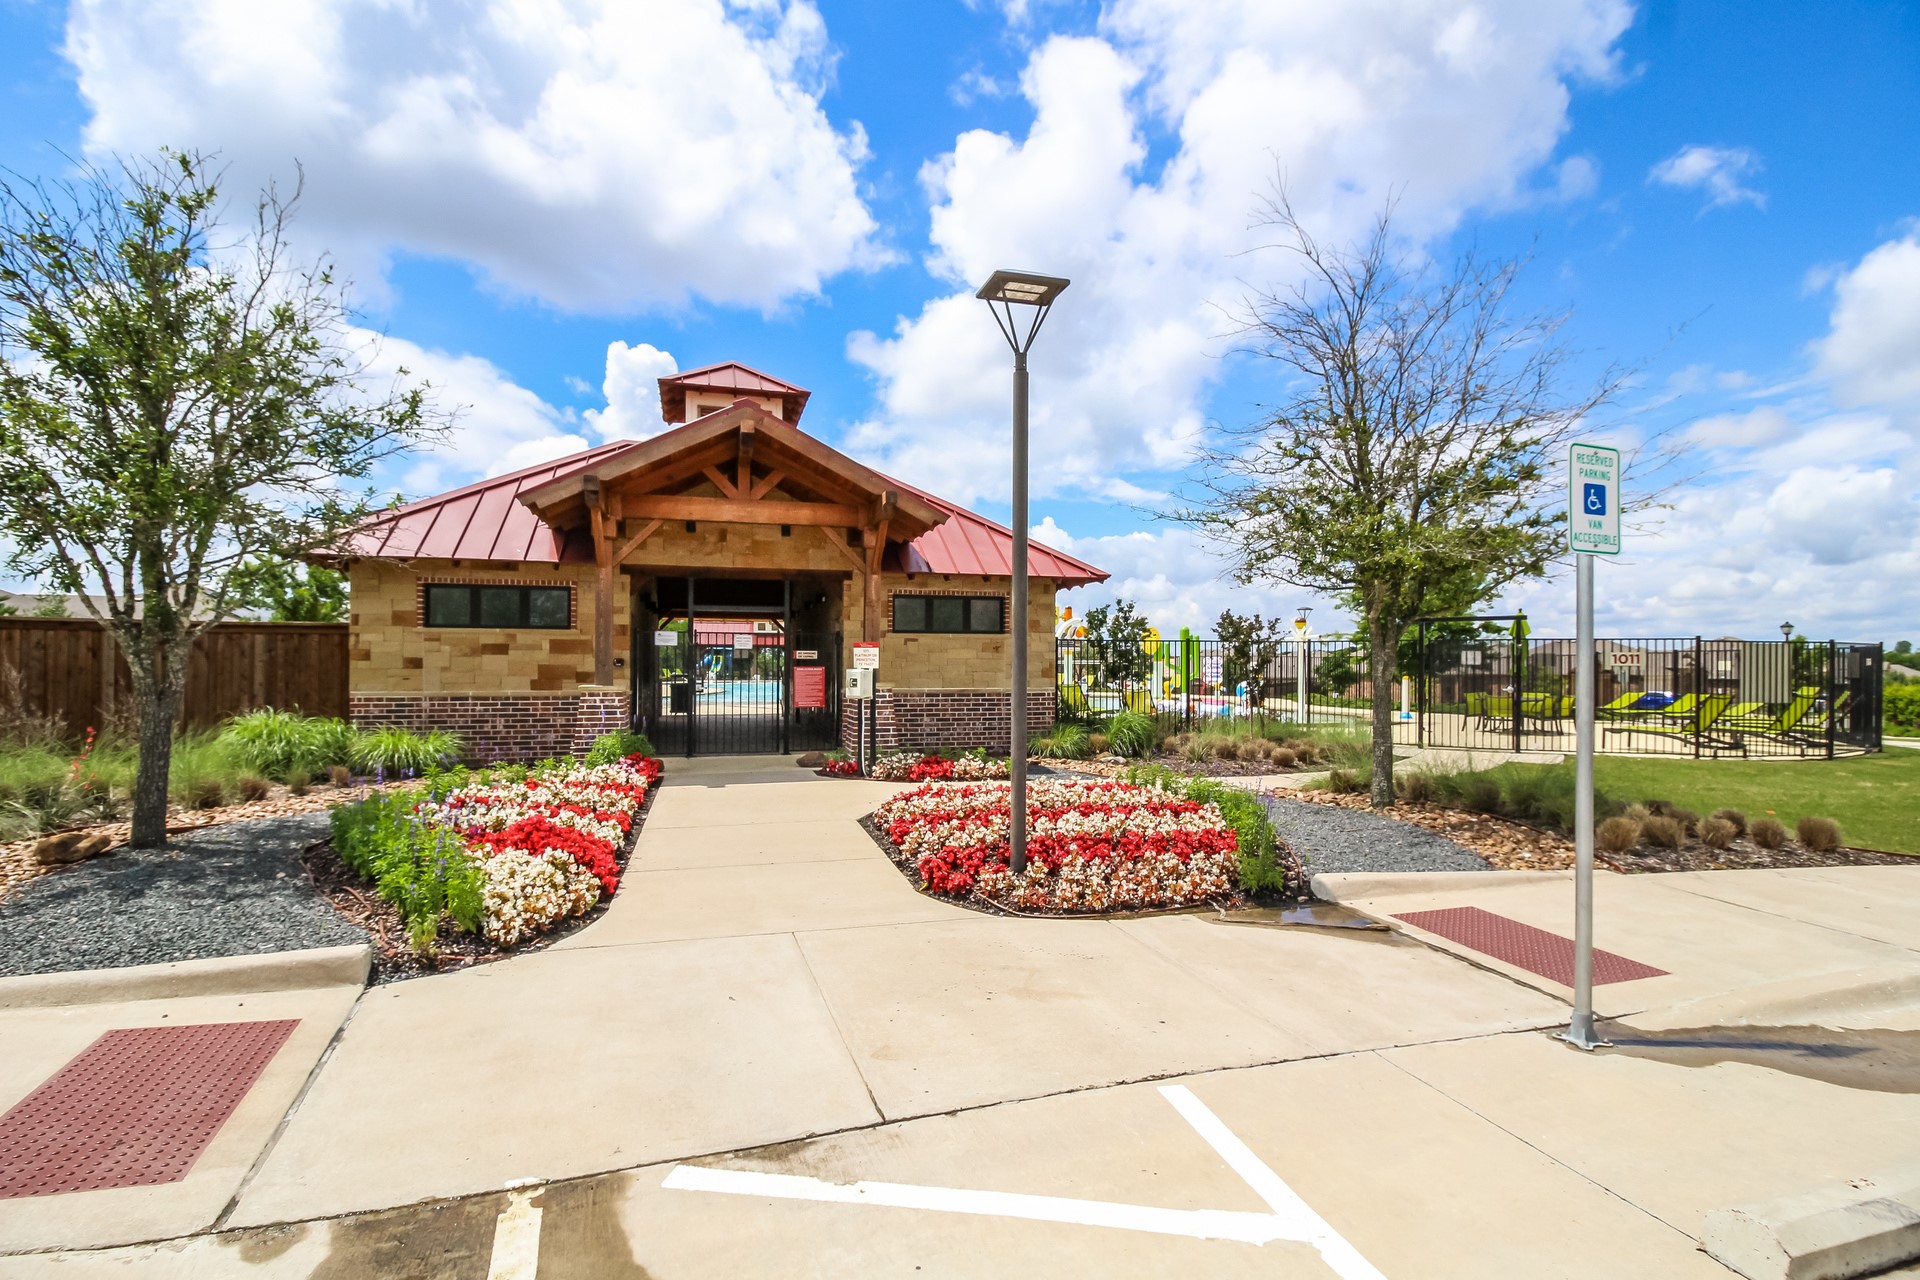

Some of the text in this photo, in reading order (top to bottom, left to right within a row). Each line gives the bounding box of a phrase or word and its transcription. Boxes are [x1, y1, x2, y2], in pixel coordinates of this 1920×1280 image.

[1576, 453, 1614, 468] RESERVED
[1579, 468, 1611, 481] PARKING
[1588, 519, 1603, 530] VAN
[1573, 532, 1617, 546] ACCESSIBLE
[1612, 654, 1640, 664] 1011
